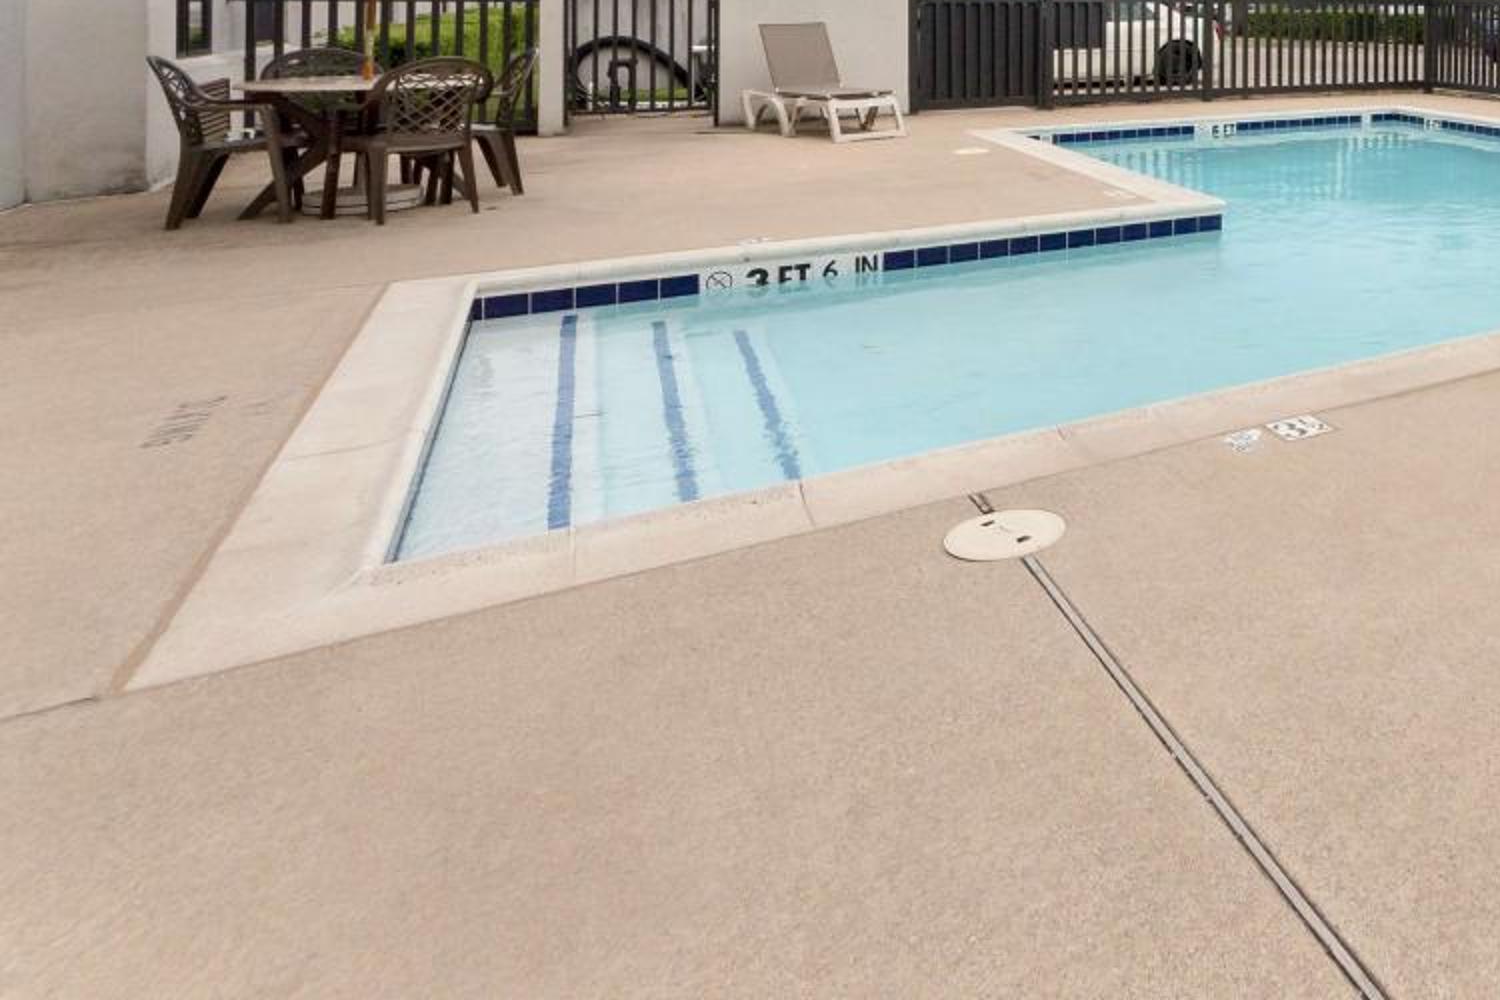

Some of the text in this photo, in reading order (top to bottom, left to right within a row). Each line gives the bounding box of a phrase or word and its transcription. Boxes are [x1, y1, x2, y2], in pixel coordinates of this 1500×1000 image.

[779, 264, 811, 284] FT
[823, 260, 838, 278] 6
[855, 255, 878, 274] IN
